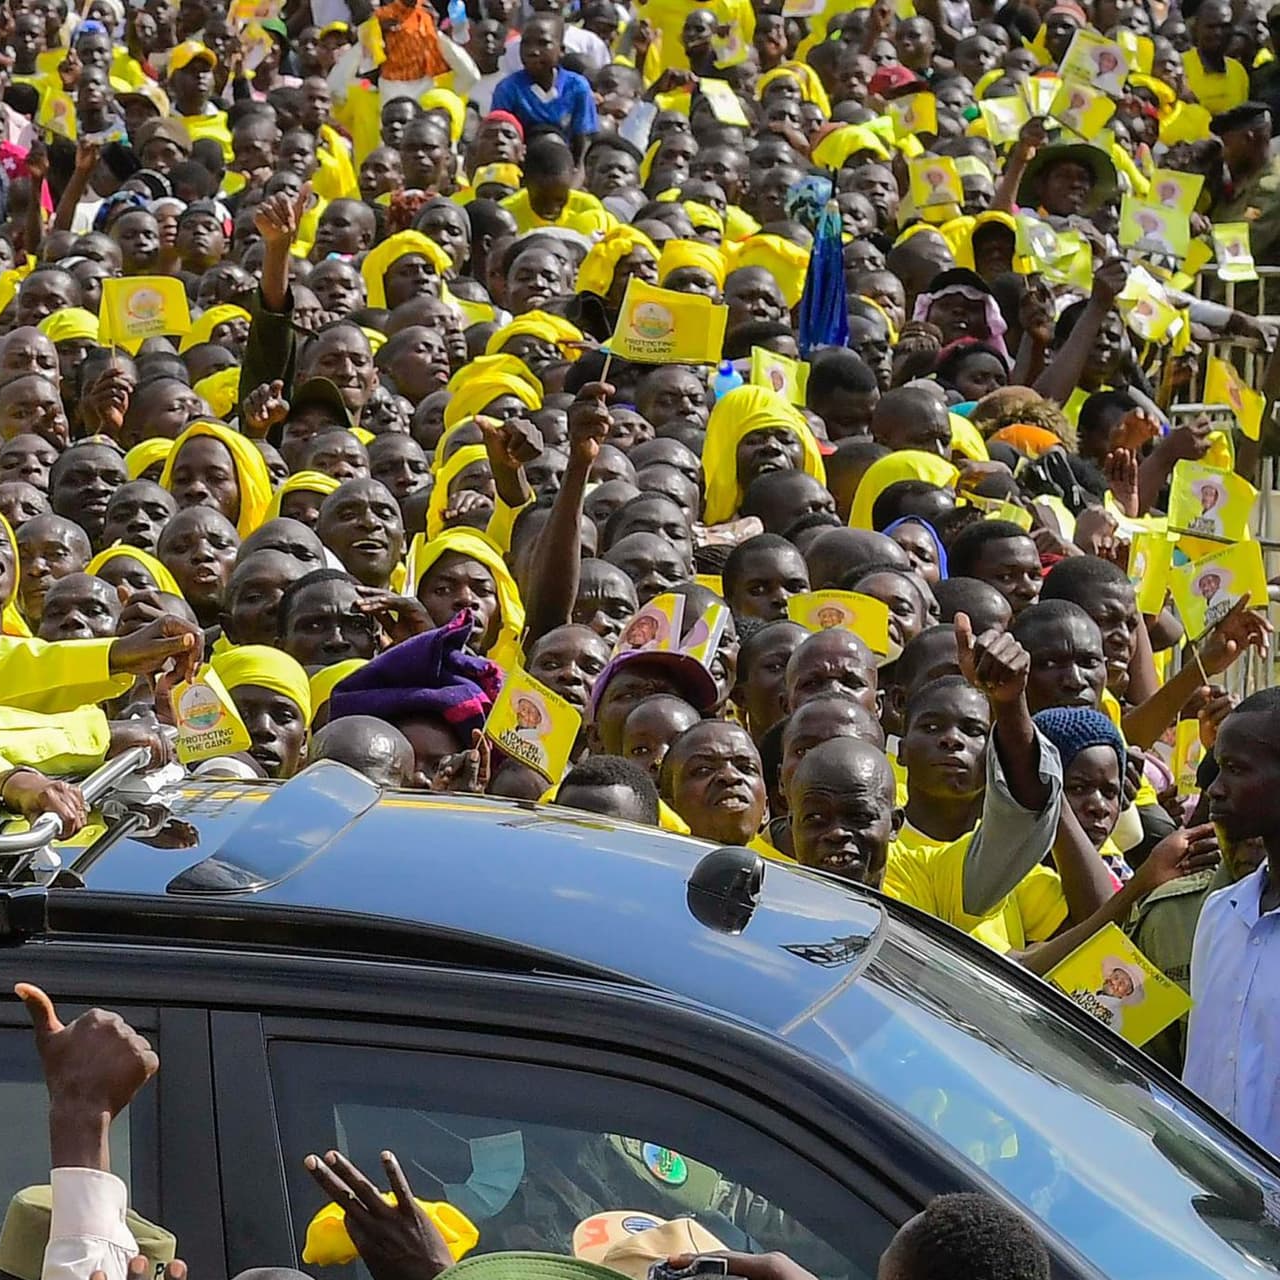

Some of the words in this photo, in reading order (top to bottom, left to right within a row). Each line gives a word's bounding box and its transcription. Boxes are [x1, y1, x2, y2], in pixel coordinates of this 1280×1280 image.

[624, 337, 676, 348] PROTECTING
[181, 728, 235, 746] PROTECTING
[187, 742, 202, 753] THE
[204, 737, 233, 751] GAINS
[506, 728, 540, 754] YOWERI
[498, 733, 543, 765] MUSEVENI
